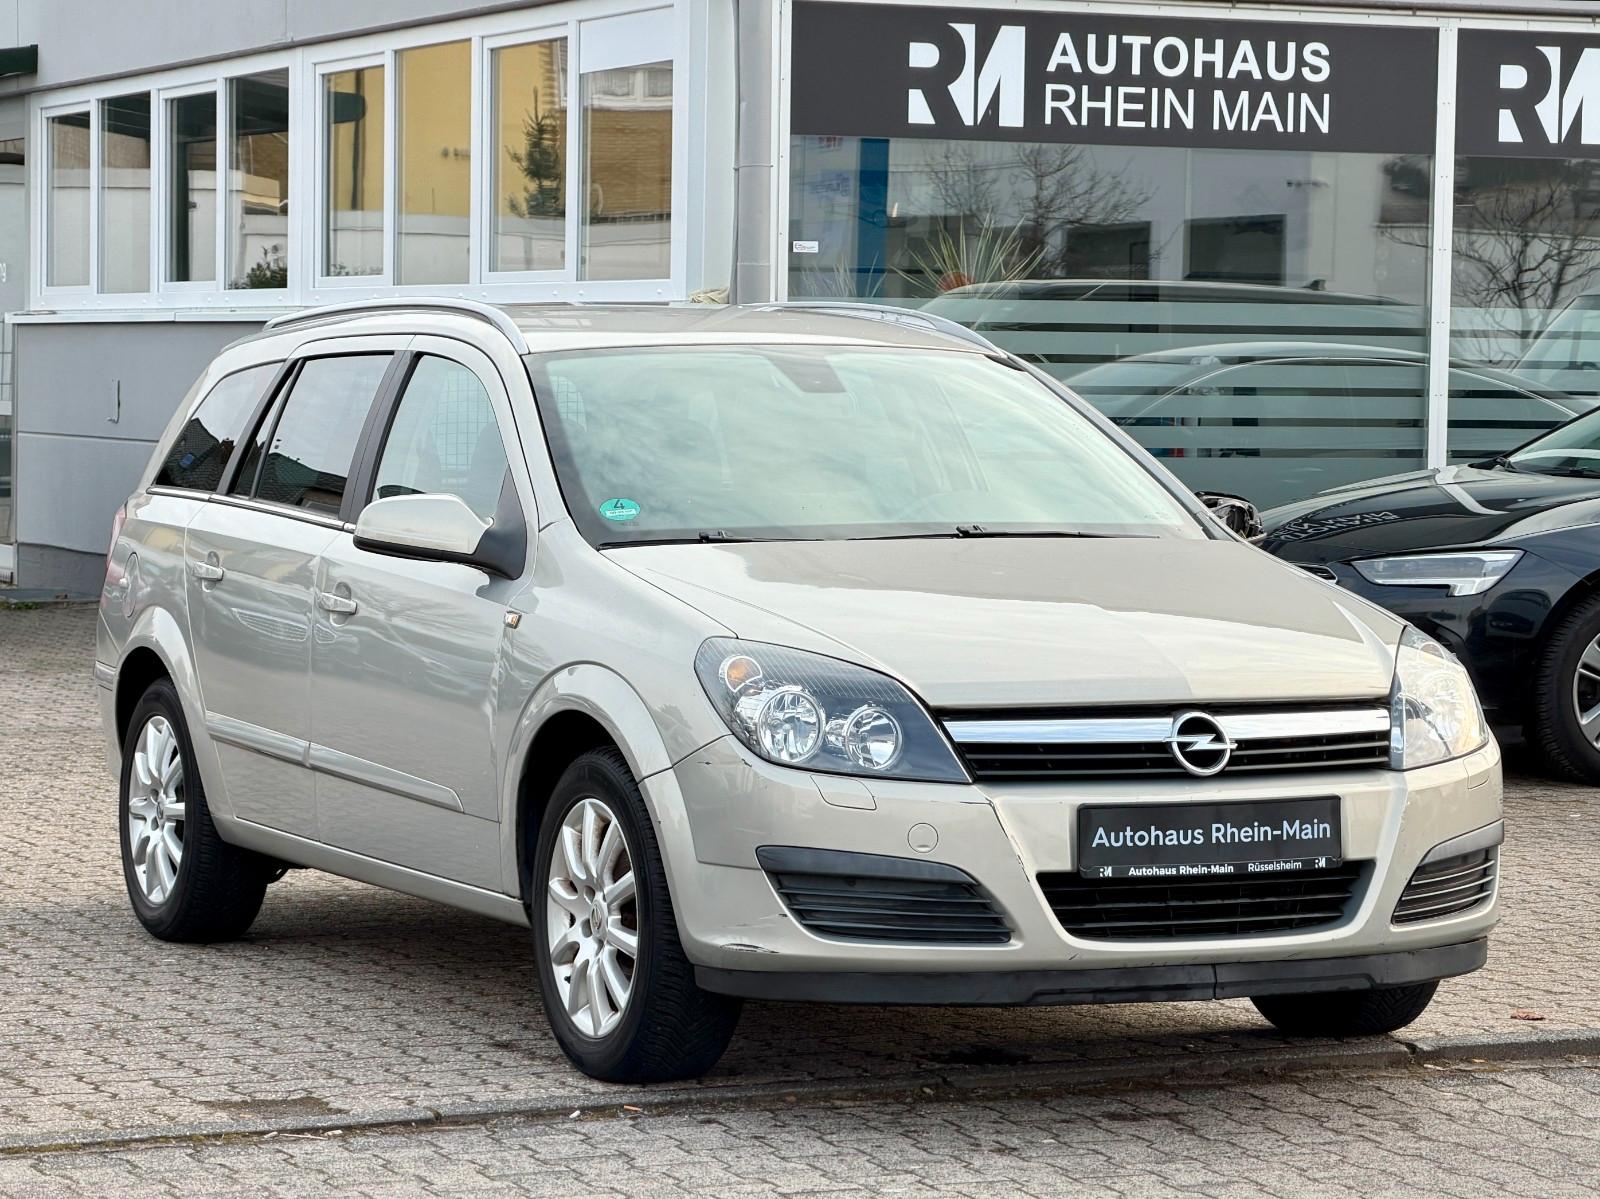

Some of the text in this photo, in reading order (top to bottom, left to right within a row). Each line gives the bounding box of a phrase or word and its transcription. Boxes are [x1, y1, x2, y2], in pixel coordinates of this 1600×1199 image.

[1046, 32, 1331, 83] AUTOHAUS
[1044, 83, 1330, 134] RHEIN MAIN
[613, 499, 625, 510] 4
[1091, 818, 1331, 848] Autohaus Rhein-Main
[1128, 865, 1177, 876] Autohaus
[1179, 863, 1234, 875] Rhein-Main
[1247, 860, 1302, 872] Rüsselsheim
